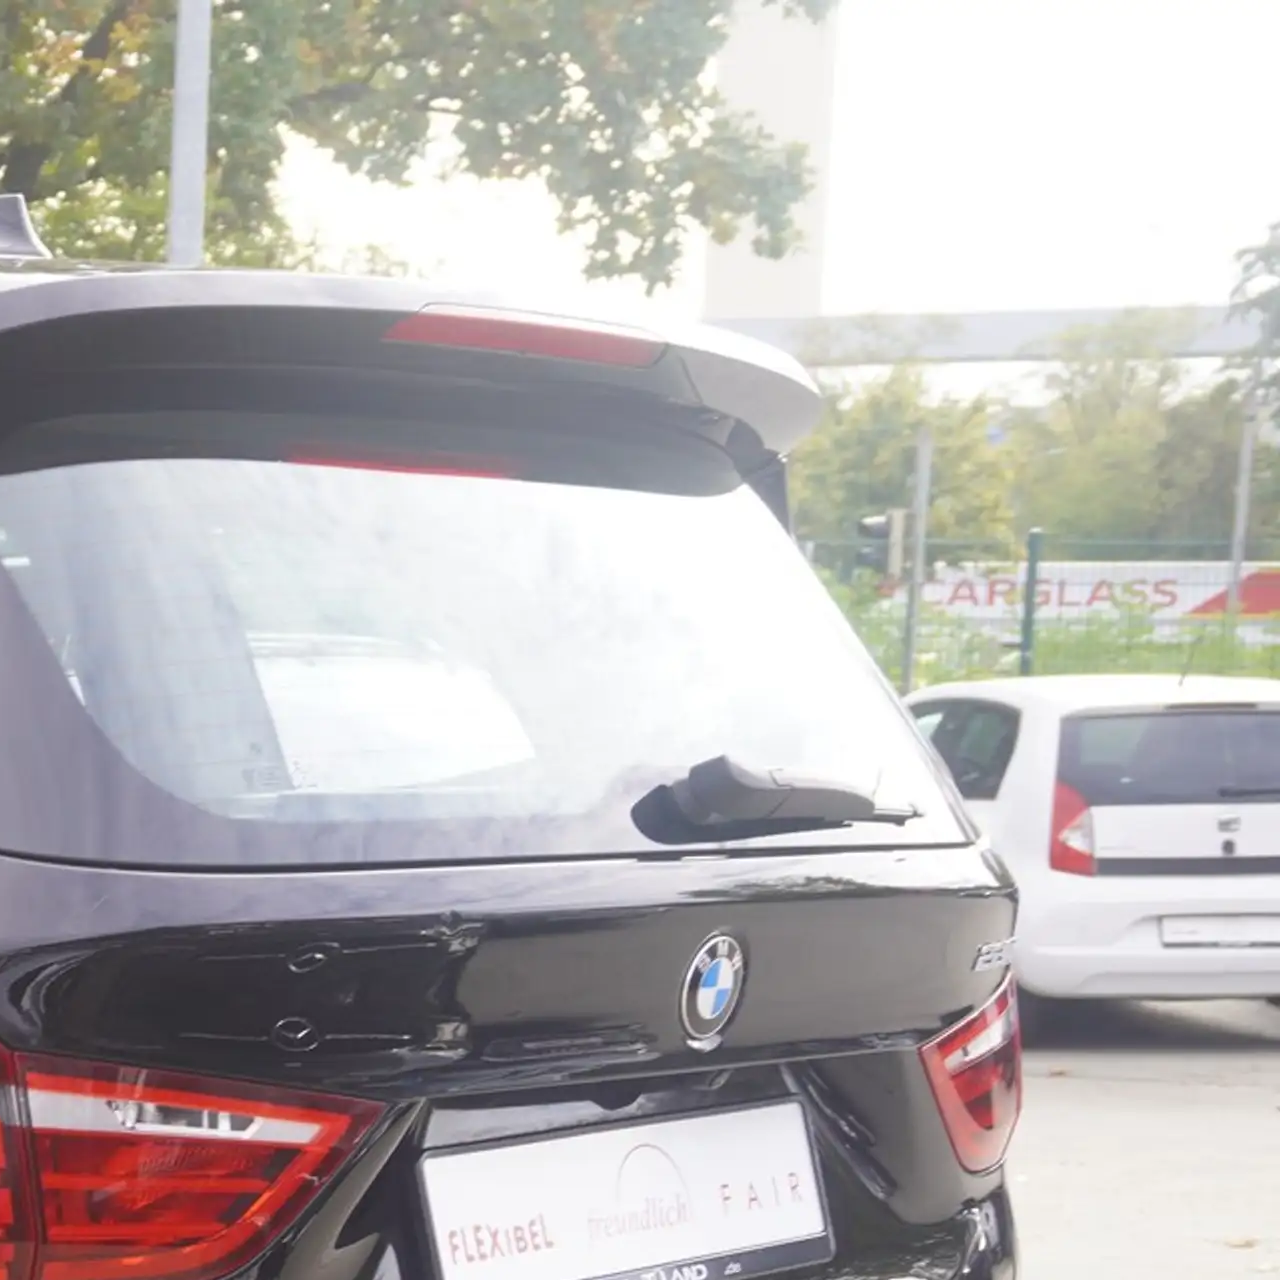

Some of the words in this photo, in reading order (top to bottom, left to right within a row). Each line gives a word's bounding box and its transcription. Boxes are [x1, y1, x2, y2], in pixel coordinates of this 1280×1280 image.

[921, 577, 1180, 608] CARGLASS
[448, 1213, 555, 1266] FLEXIBEL
[586, 1192, 690, 1241] freundlich
[720, 1171, 803, 1219] FAIR
